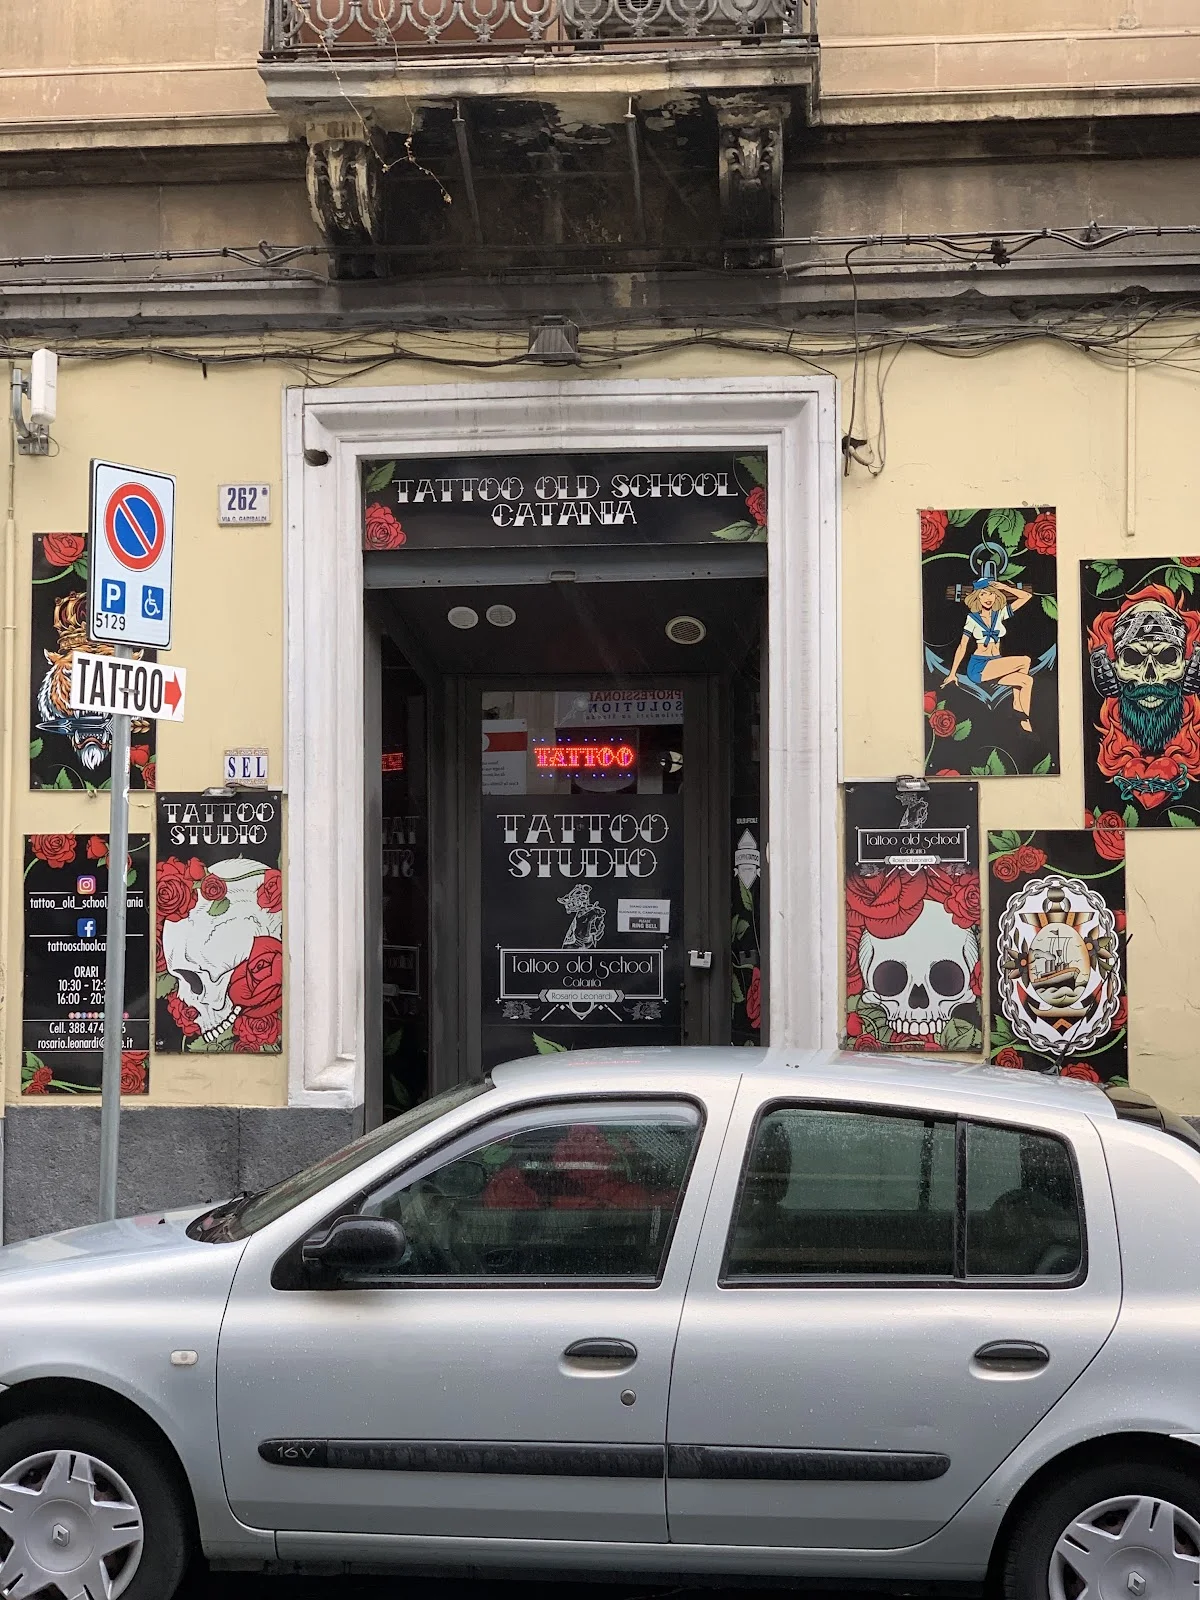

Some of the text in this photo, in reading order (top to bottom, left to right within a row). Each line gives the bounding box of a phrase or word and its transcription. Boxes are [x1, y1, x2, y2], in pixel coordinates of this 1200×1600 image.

[392, 472, 738, 503] TATTOO OLD SCHOOL
[228, 487, 257, 511] 262
[491, 500, 637, 527] CATANIA
[106, 583, 121, 609] P
[96, 612, 126, 631] 5129
[77, 658, 163, 714] TATTOO
[534, 747, 634, 767] TATTOO
[228, 757, 266, 778] SEL
[163, 803, 275, 823] TATTOO
[170, 825, 268, 845] STUDIO
[497, 814, 669, 844] TATTOO
[901, 833, 920, 846] old
[508, 848, 658, 878] STUDIO
[30, 895, 144, 910] tattoo_old_schoolania
[47, 938, 107, 952] tattooschoolca
[74, 965, 99, 978] ORARI
[566, 955, 593, 974] old
[595, 955, 653, 980] school
[58, 979, 82, 992] 10:30
[92, 979, 106, 992] 12:3
[56, 992, 80, 1005] 16:00
[551, 992, 613, 1001] Rosario Leonardi
[49, 1022, 126, 1034] Cell. 388.4746
[277, 1446, 316, 1459] 16V
